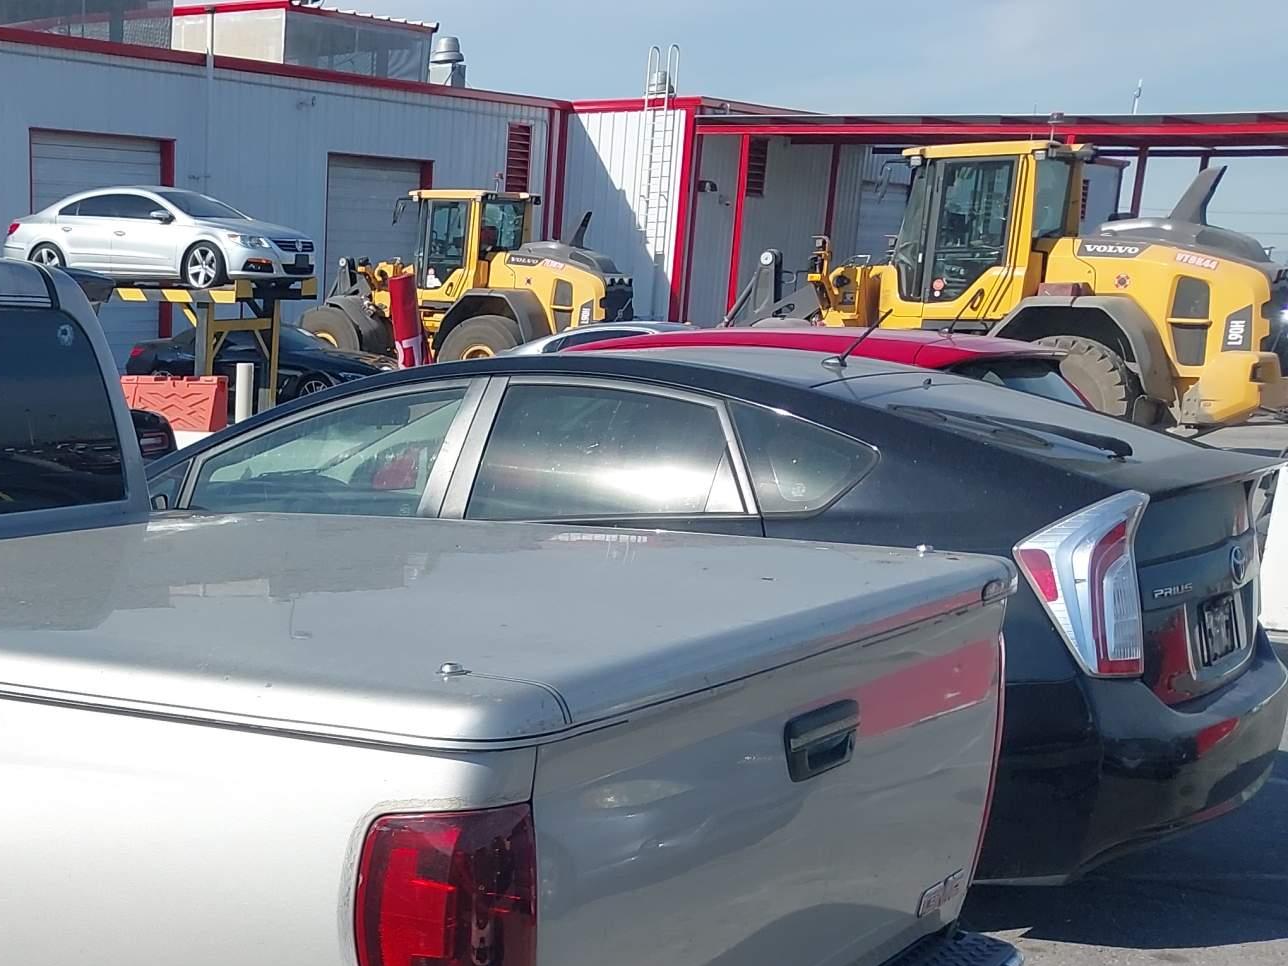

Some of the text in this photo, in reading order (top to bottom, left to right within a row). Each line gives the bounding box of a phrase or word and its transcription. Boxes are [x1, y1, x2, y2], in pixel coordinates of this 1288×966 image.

[1084, 244, 1140, 254] VOLVO
[1227, 319, 1246, 346] L90H
[1153, 582, 1193, 599] PRIUS
